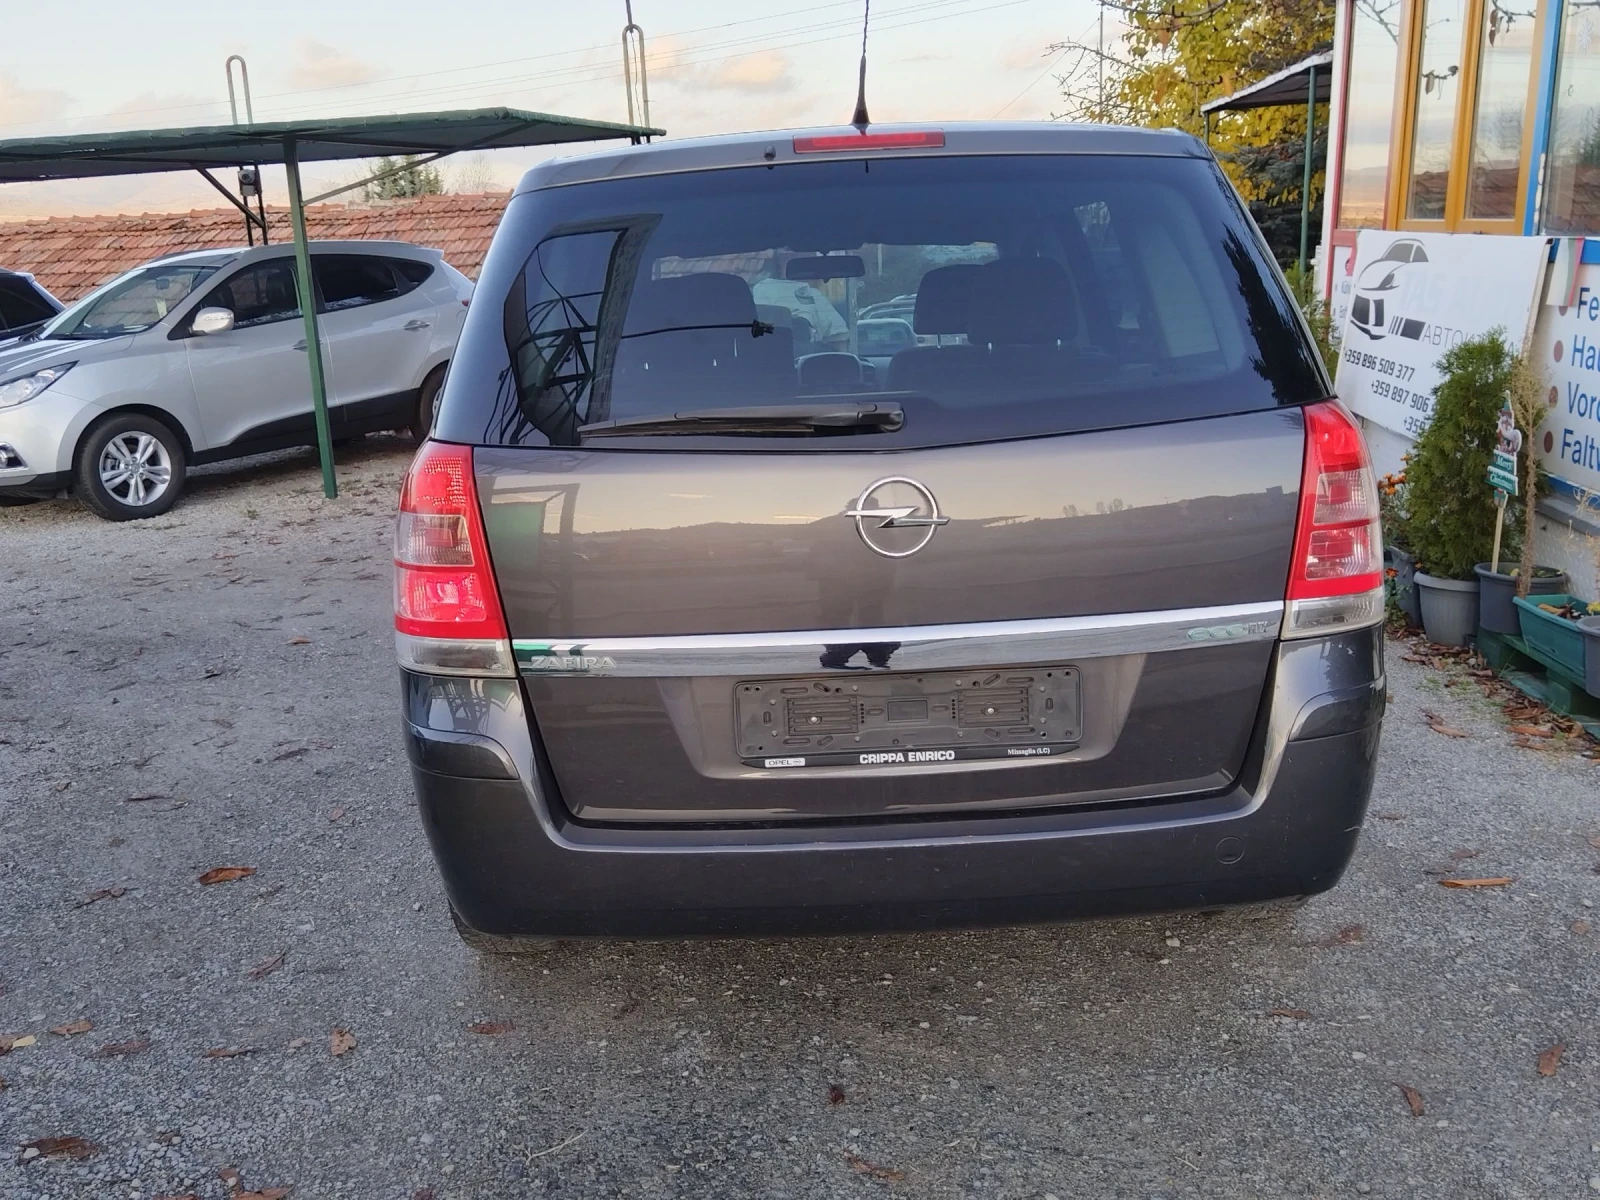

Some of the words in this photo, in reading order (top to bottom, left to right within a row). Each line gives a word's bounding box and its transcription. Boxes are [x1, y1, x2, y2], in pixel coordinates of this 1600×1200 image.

[1344, 349, 1361, 366] +359
[1361, 353, 1378, 371] 896
[1378, 358, 1395, 376] 509
[1395, 363, 1415, 382] 377
[1371, 379, 1391, 398] +359
[1391, 386, 1410, 405] 897
[1410, 393, 1430, 413] 906
[531, 655, 617, 669] ZAFIRA
[859, 752, 905, 765] CRIPPA
[907, 750, 955, 762] ENRICO
[1036, 747, 1051, 755] (LC)
